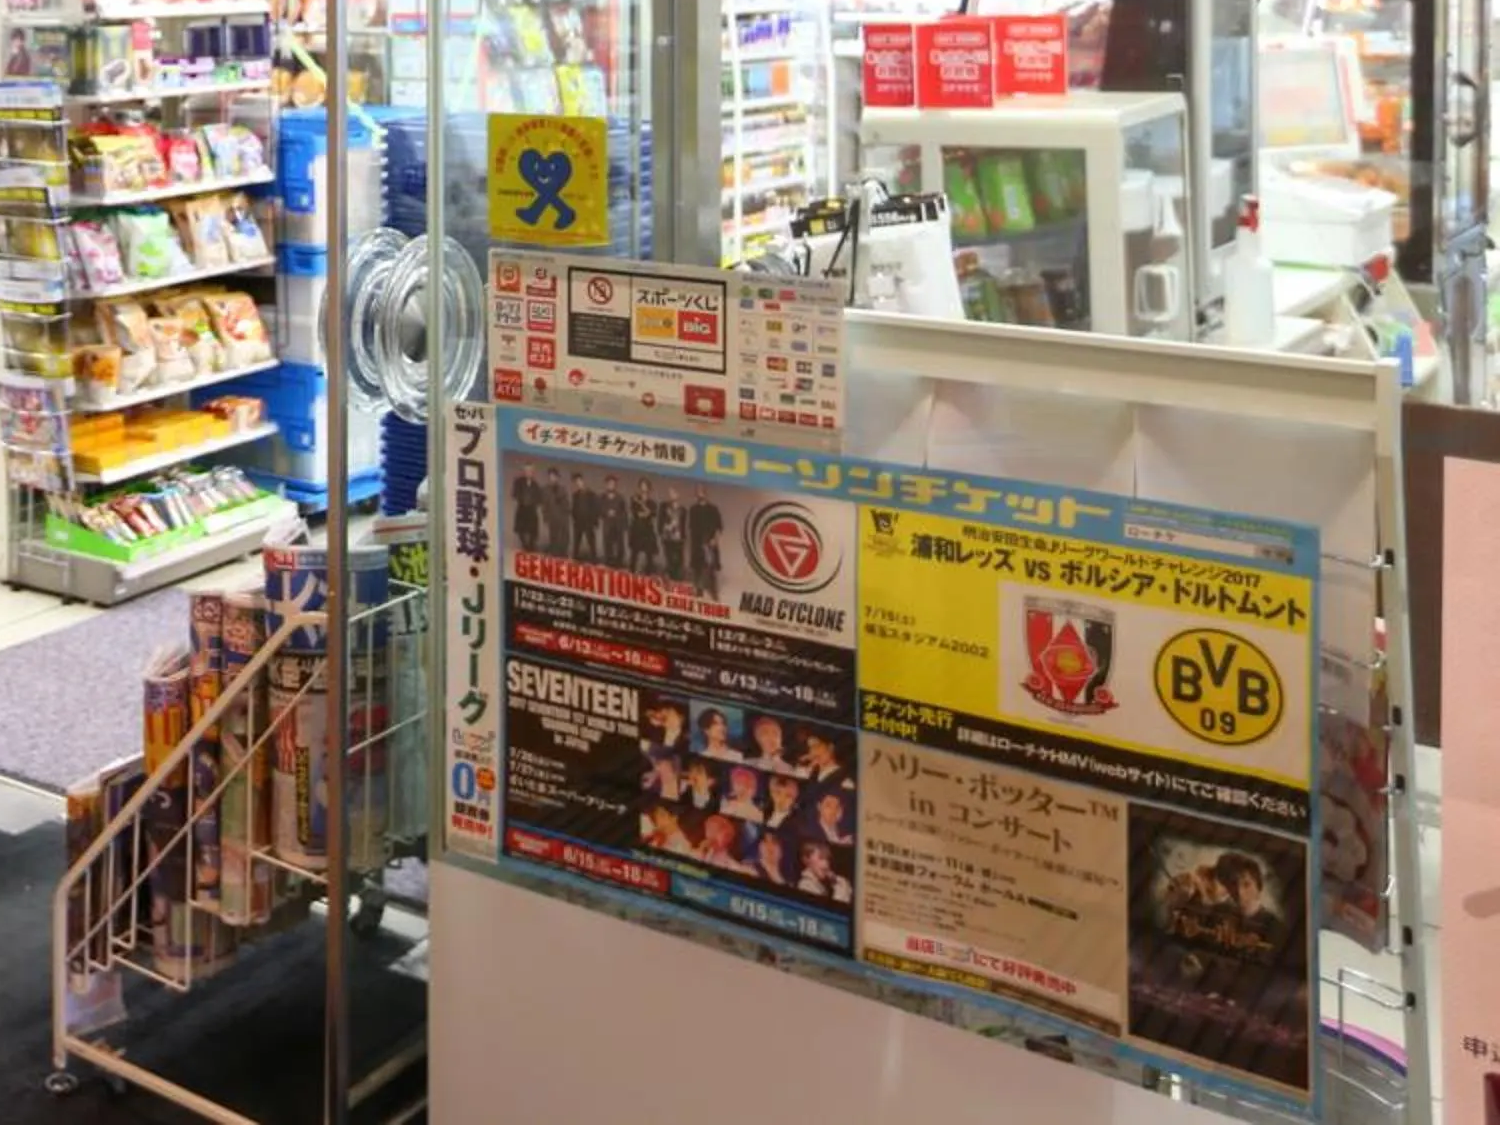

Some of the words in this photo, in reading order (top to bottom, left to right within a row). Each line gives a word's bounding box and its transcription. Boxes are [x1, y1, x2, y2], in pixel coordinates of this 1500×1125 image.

[636, 287, 719, 311] スポーツくじ
[597, 434, 687, 464] チケット情報
[705, 444, 1111, 528] ローソンチケット
[514, 552, 663, 608] GENERATIONS
[910, 531, 1015, 574] 浦和レッズ
[1024, 558, 1051, 582] VS
[1059, 560, 1307, 627] ボルシア・ドルトムント
[739, 590, 774, 618] MAD
[776, 598, 846, 633] CYCLONE
[507, 659, 639, 722] SEVENTEEN
[1171, 638, 1270, 716] BVB
[1200, 707, 1237, 736] 09
[909, 791, 935, 817] in
[948, 802, 1073, 854] コンサート
